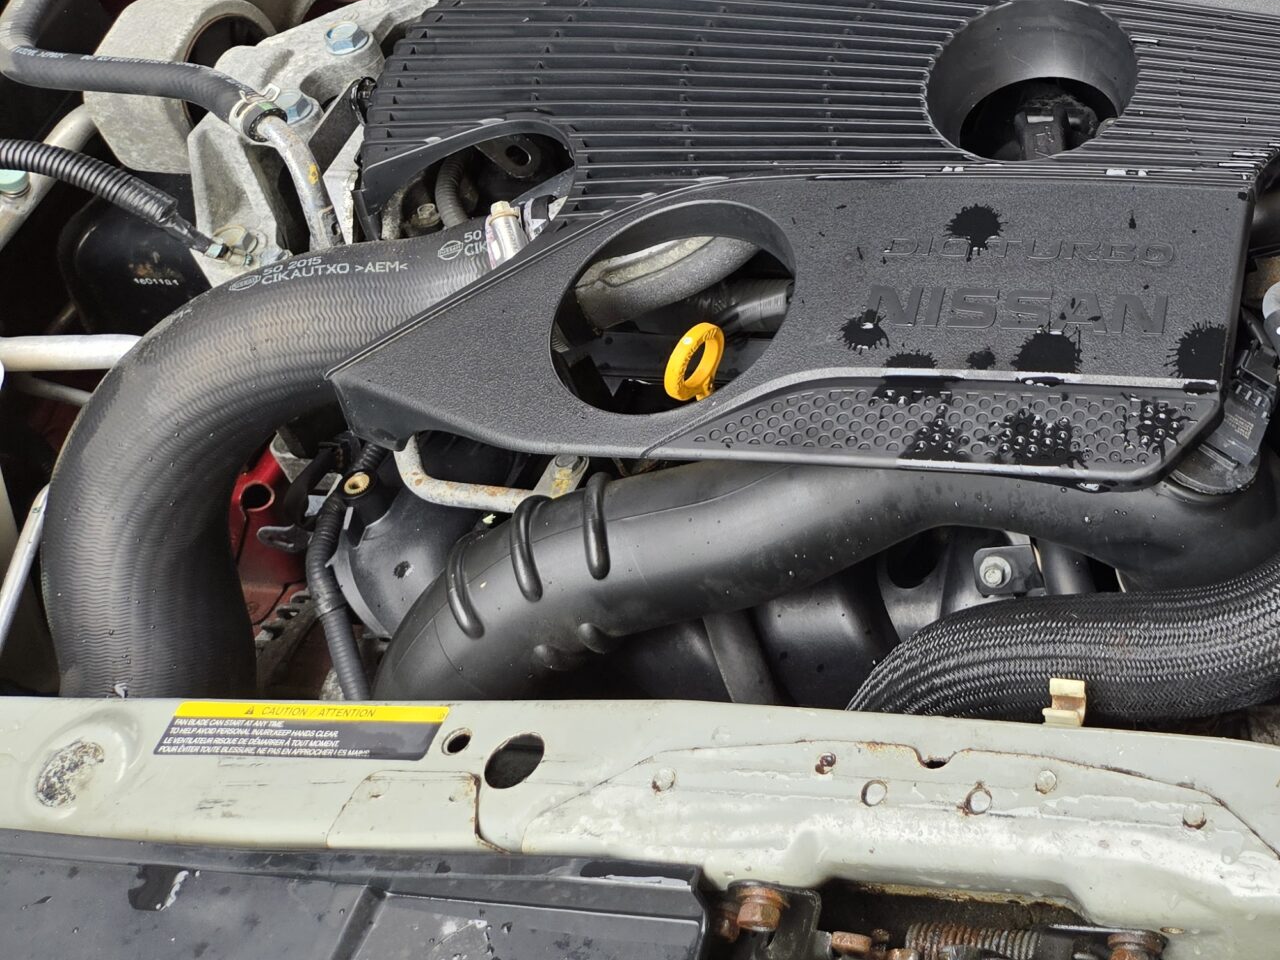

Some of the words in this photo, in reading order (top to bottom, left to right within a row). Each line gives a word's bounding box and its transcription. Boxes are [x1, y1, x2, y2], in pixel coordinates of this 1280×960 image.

[463, 229, 482, 242] 50
[986, 237, 1175, 264] TURBO
[260, 262, 350, 285] CIKAUTXO
[354, 261, 408, 274] >AEM<
[262, 265, 284, 277] 50
[287, 256, 323, 270] 2015
[864, 284, 1170, 334] NISSAN
[262, 706, 309, 716] CAUTION
[318, 708, 377, 718] ATTENTION
[178, 744, 197, 752] ÉVITER
[257, 747, 267, 755] NE
[291, 748, 334, 756] APPROCHER
[247, 737, 285, 746] DÉMARRER
